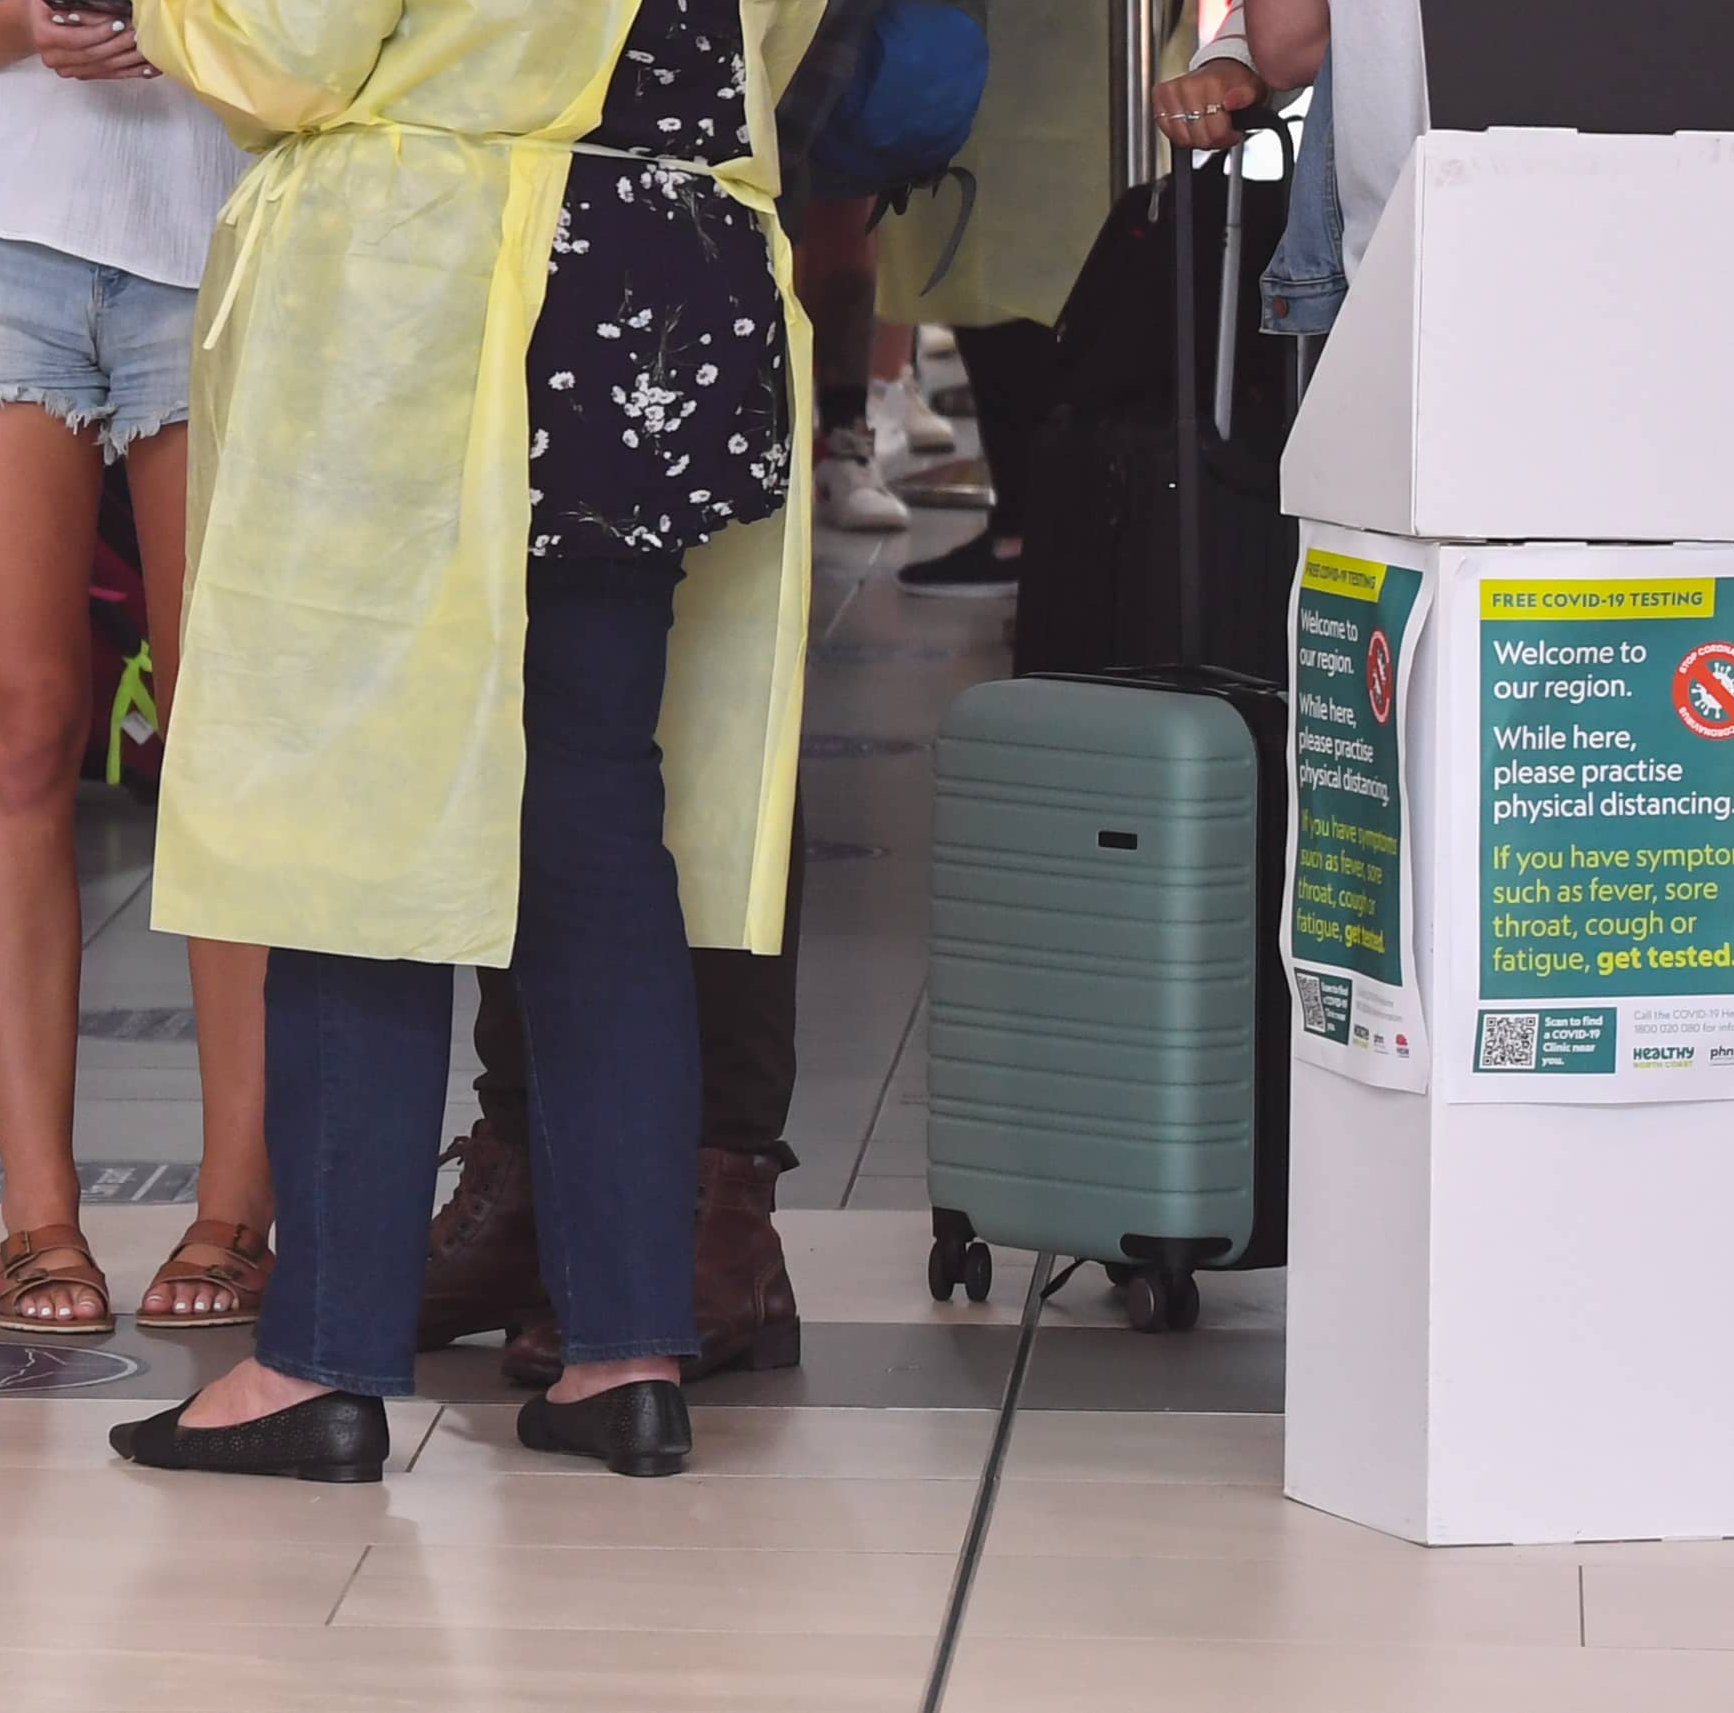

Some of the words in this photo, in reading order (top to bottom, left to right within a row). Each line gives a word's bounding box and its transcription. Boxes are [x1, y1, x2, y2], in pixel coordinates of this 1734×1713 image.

[1492, 592, 1537, 609] FREE
[1542, 592, 1625, 609] COVID-19
[1630, 591, 1704, 608] TESTING
[1300, 607, 1346, 640] Welcome
[1346, 619, 1358, 642] to
[1299, 647, 1316, 667] our
[1317, 649, 1355, 677] region.
[1493, 639, 1614, 665] Welcome
[1620, 641, 1647, 664] to
[1679, 651, 1699, 676] STOP
[1493, 680, 1539, 699] our
[1544, 675, 1633, 705] region.
[1298, 692, 1328, 721] While
[1329, 697, 1357, 729] here,
[1298, 726, 1333, 755] please
[1334, 737, 1374, 764] practise
[1493, 725, 1566, 751] While
[1573, 724, 1637, 752] here,
[1299, 758, 1341, 791] physical
[1343, 766, 1390, 808] distancing.
[1493, 759, 1575, 790] please
[1581, 758, 1683, 789] practise
[1493, 792, 1594, 824] physical
[1331, 814, 1357, 844] have
[1300, 847, 1323, 867] such
[1325, 853, 1339, 873] as
[1493, 844, 1511, 870] If
[1516, 849, 1564, 876] you
[1570, 844, 1630, 869] have
[1297, 876, 1337, 909] throat,
[1493, 879, 1550, 905] such
[1556, 884, 1583, 903] as
[1589, 877, 1658, 905] fever,
[1665, 881, 1718, 902] sore
[1296, 907, 1343, 943] fatigue,
[1493, 913, 1579, 940] throat,
[1585, 910, 1664, 941] cough
[1670, 915, 1698, 934] or
[1492, 947, 1591, 978] fatigue,
[1597, 946, 1642, 976] get
[1544, 1016, 1569, 1028] Scan
[1569, 1016, 1581, 1028] to
[1582, 1015, 1604, 1028] find
[1633, 1010, 1652, 1021] Call
[1653, 1010, 1671, 1021] the
[1672, 1009, 1720, 1021] COVID-19
[1634, 1023, 1658, 1035] 1800
[1702, 1021, 1716, 1033] for
[1542, 1041, 1570, 1054] Clinic
[1572, 1043, 1597, 1053] near
[1552, 1028, 1601, 1040] COVID-19
[1541, 1056, 1565, 1068] you.
[1709, 1045, 1734, 1061] phn
